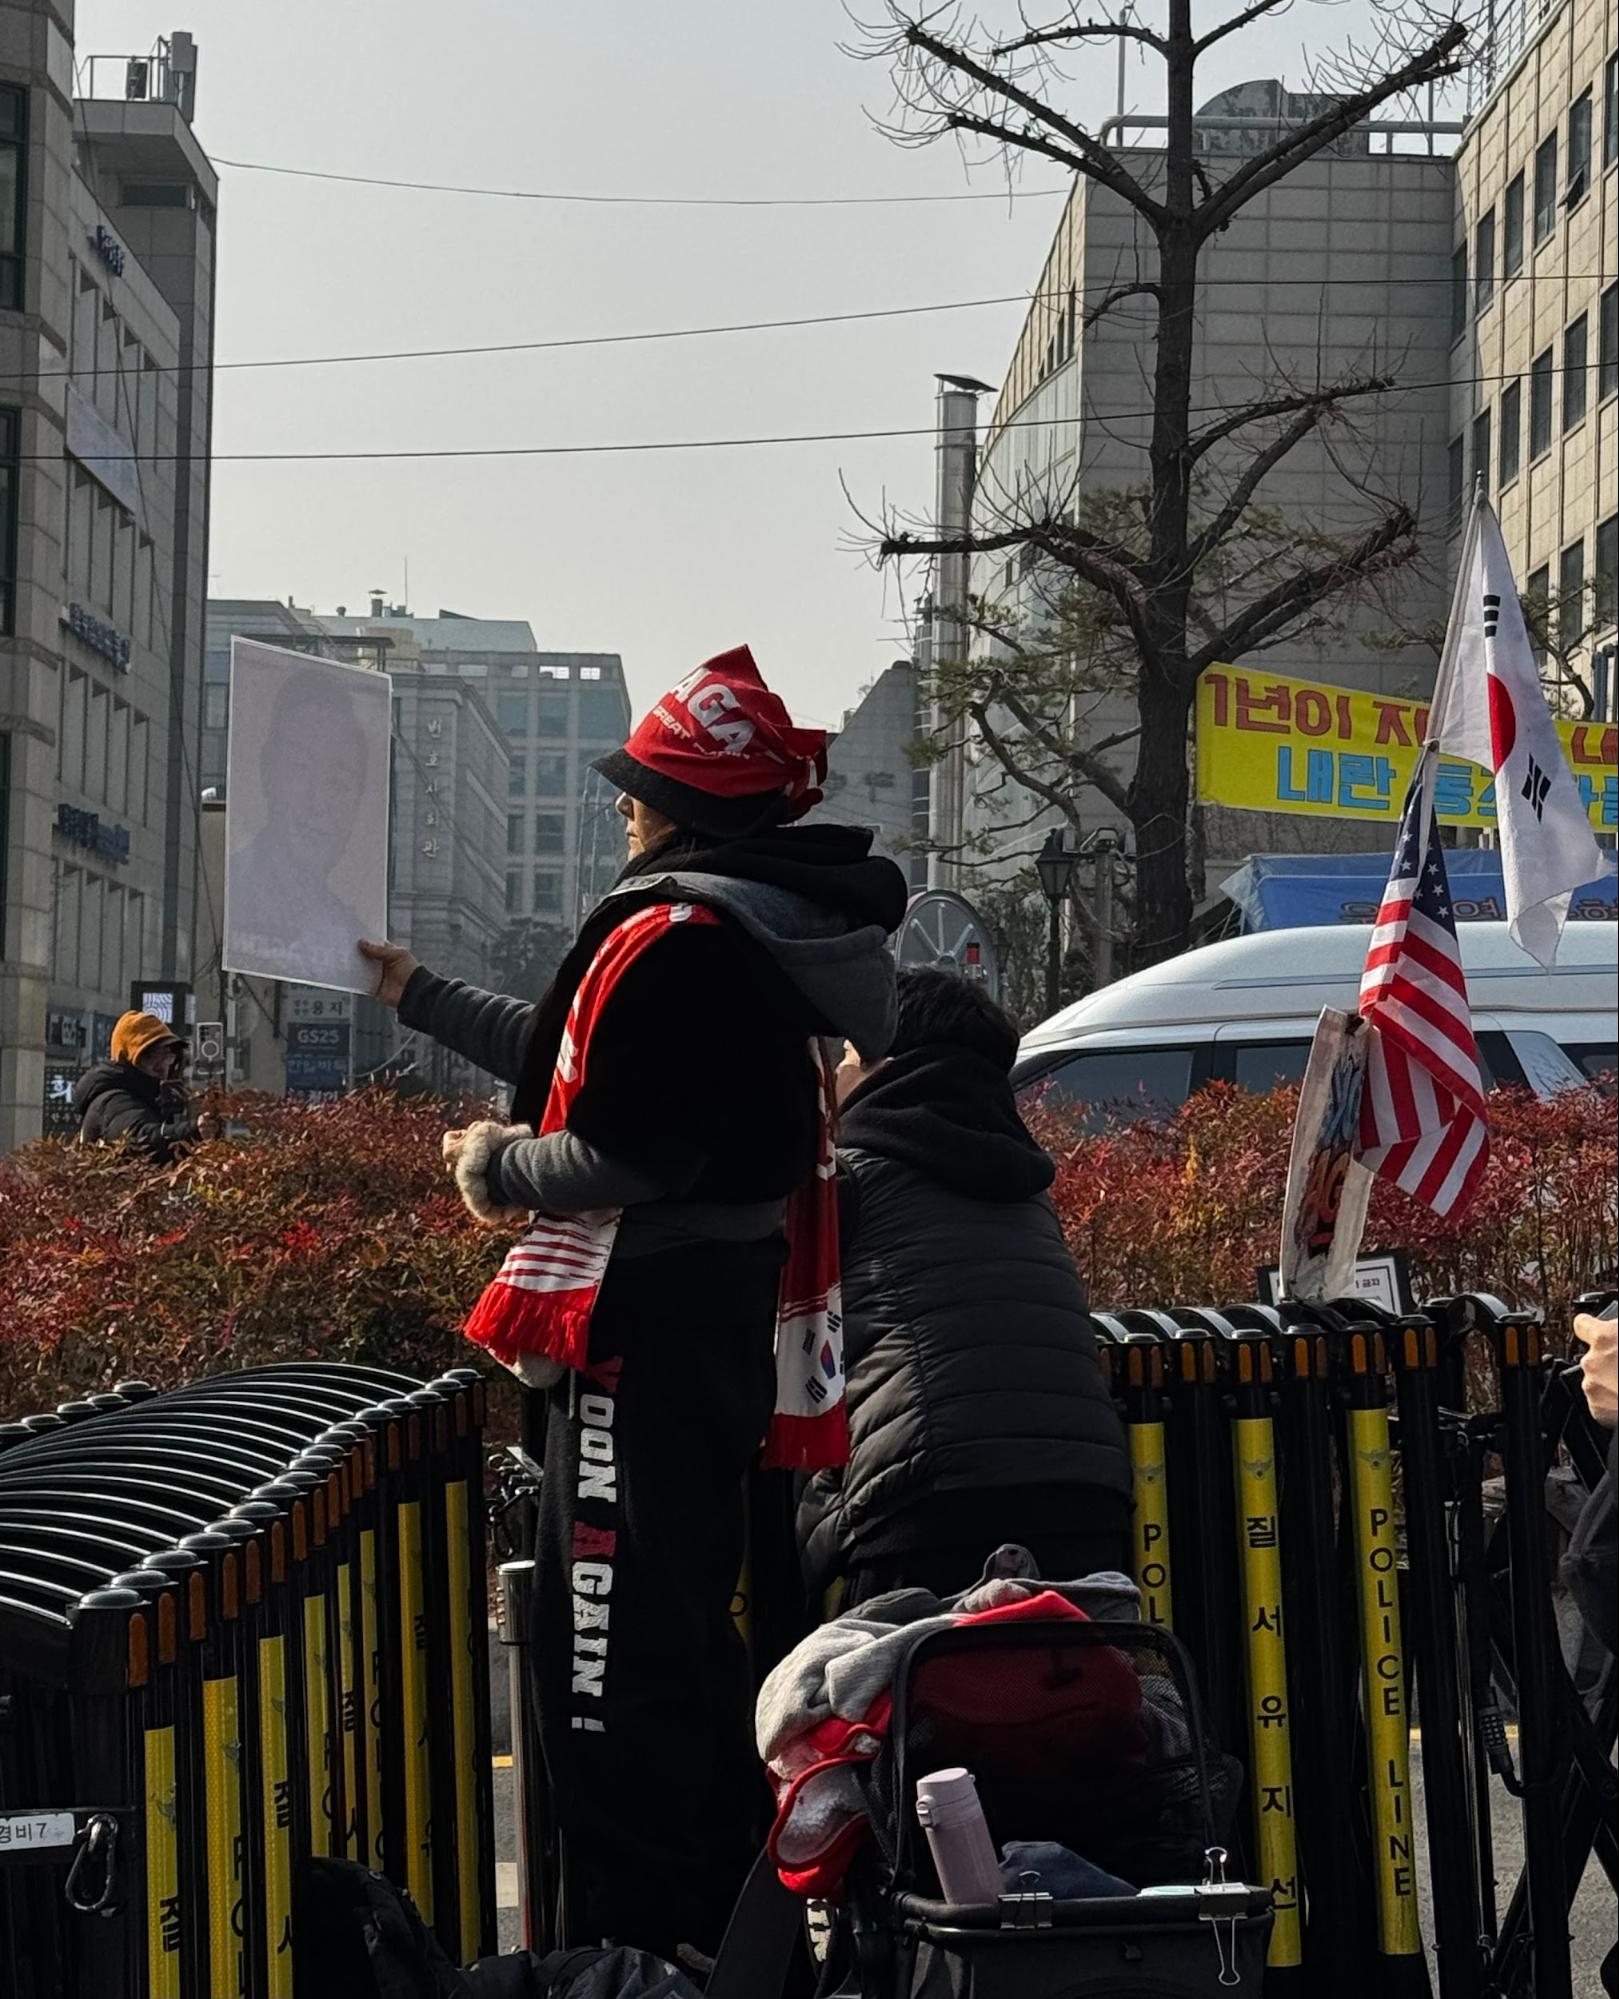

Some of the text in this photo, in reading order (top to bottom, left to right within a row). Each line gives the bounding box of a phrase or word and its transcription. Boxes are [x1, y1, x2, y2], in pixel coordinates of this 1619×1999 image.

[652, 705, 692, 740] GREAT
[1204, 673, 1352, 740] 1년이
[1276, 745, 1397, 811] 내란
[297, 1028, 340, 1044] GS25
[577, 1355, 624, 1503] YOON
[571, 1521, 617, 1697] AGAIN
[1141, 1523, 1167, 1625] POL
[1246, 1516, 1298, 1909] 질서유지선
[1369, 1508, 1412, 1897] POLICE LINE
[0, 1822, 47, 1844] 경비7
